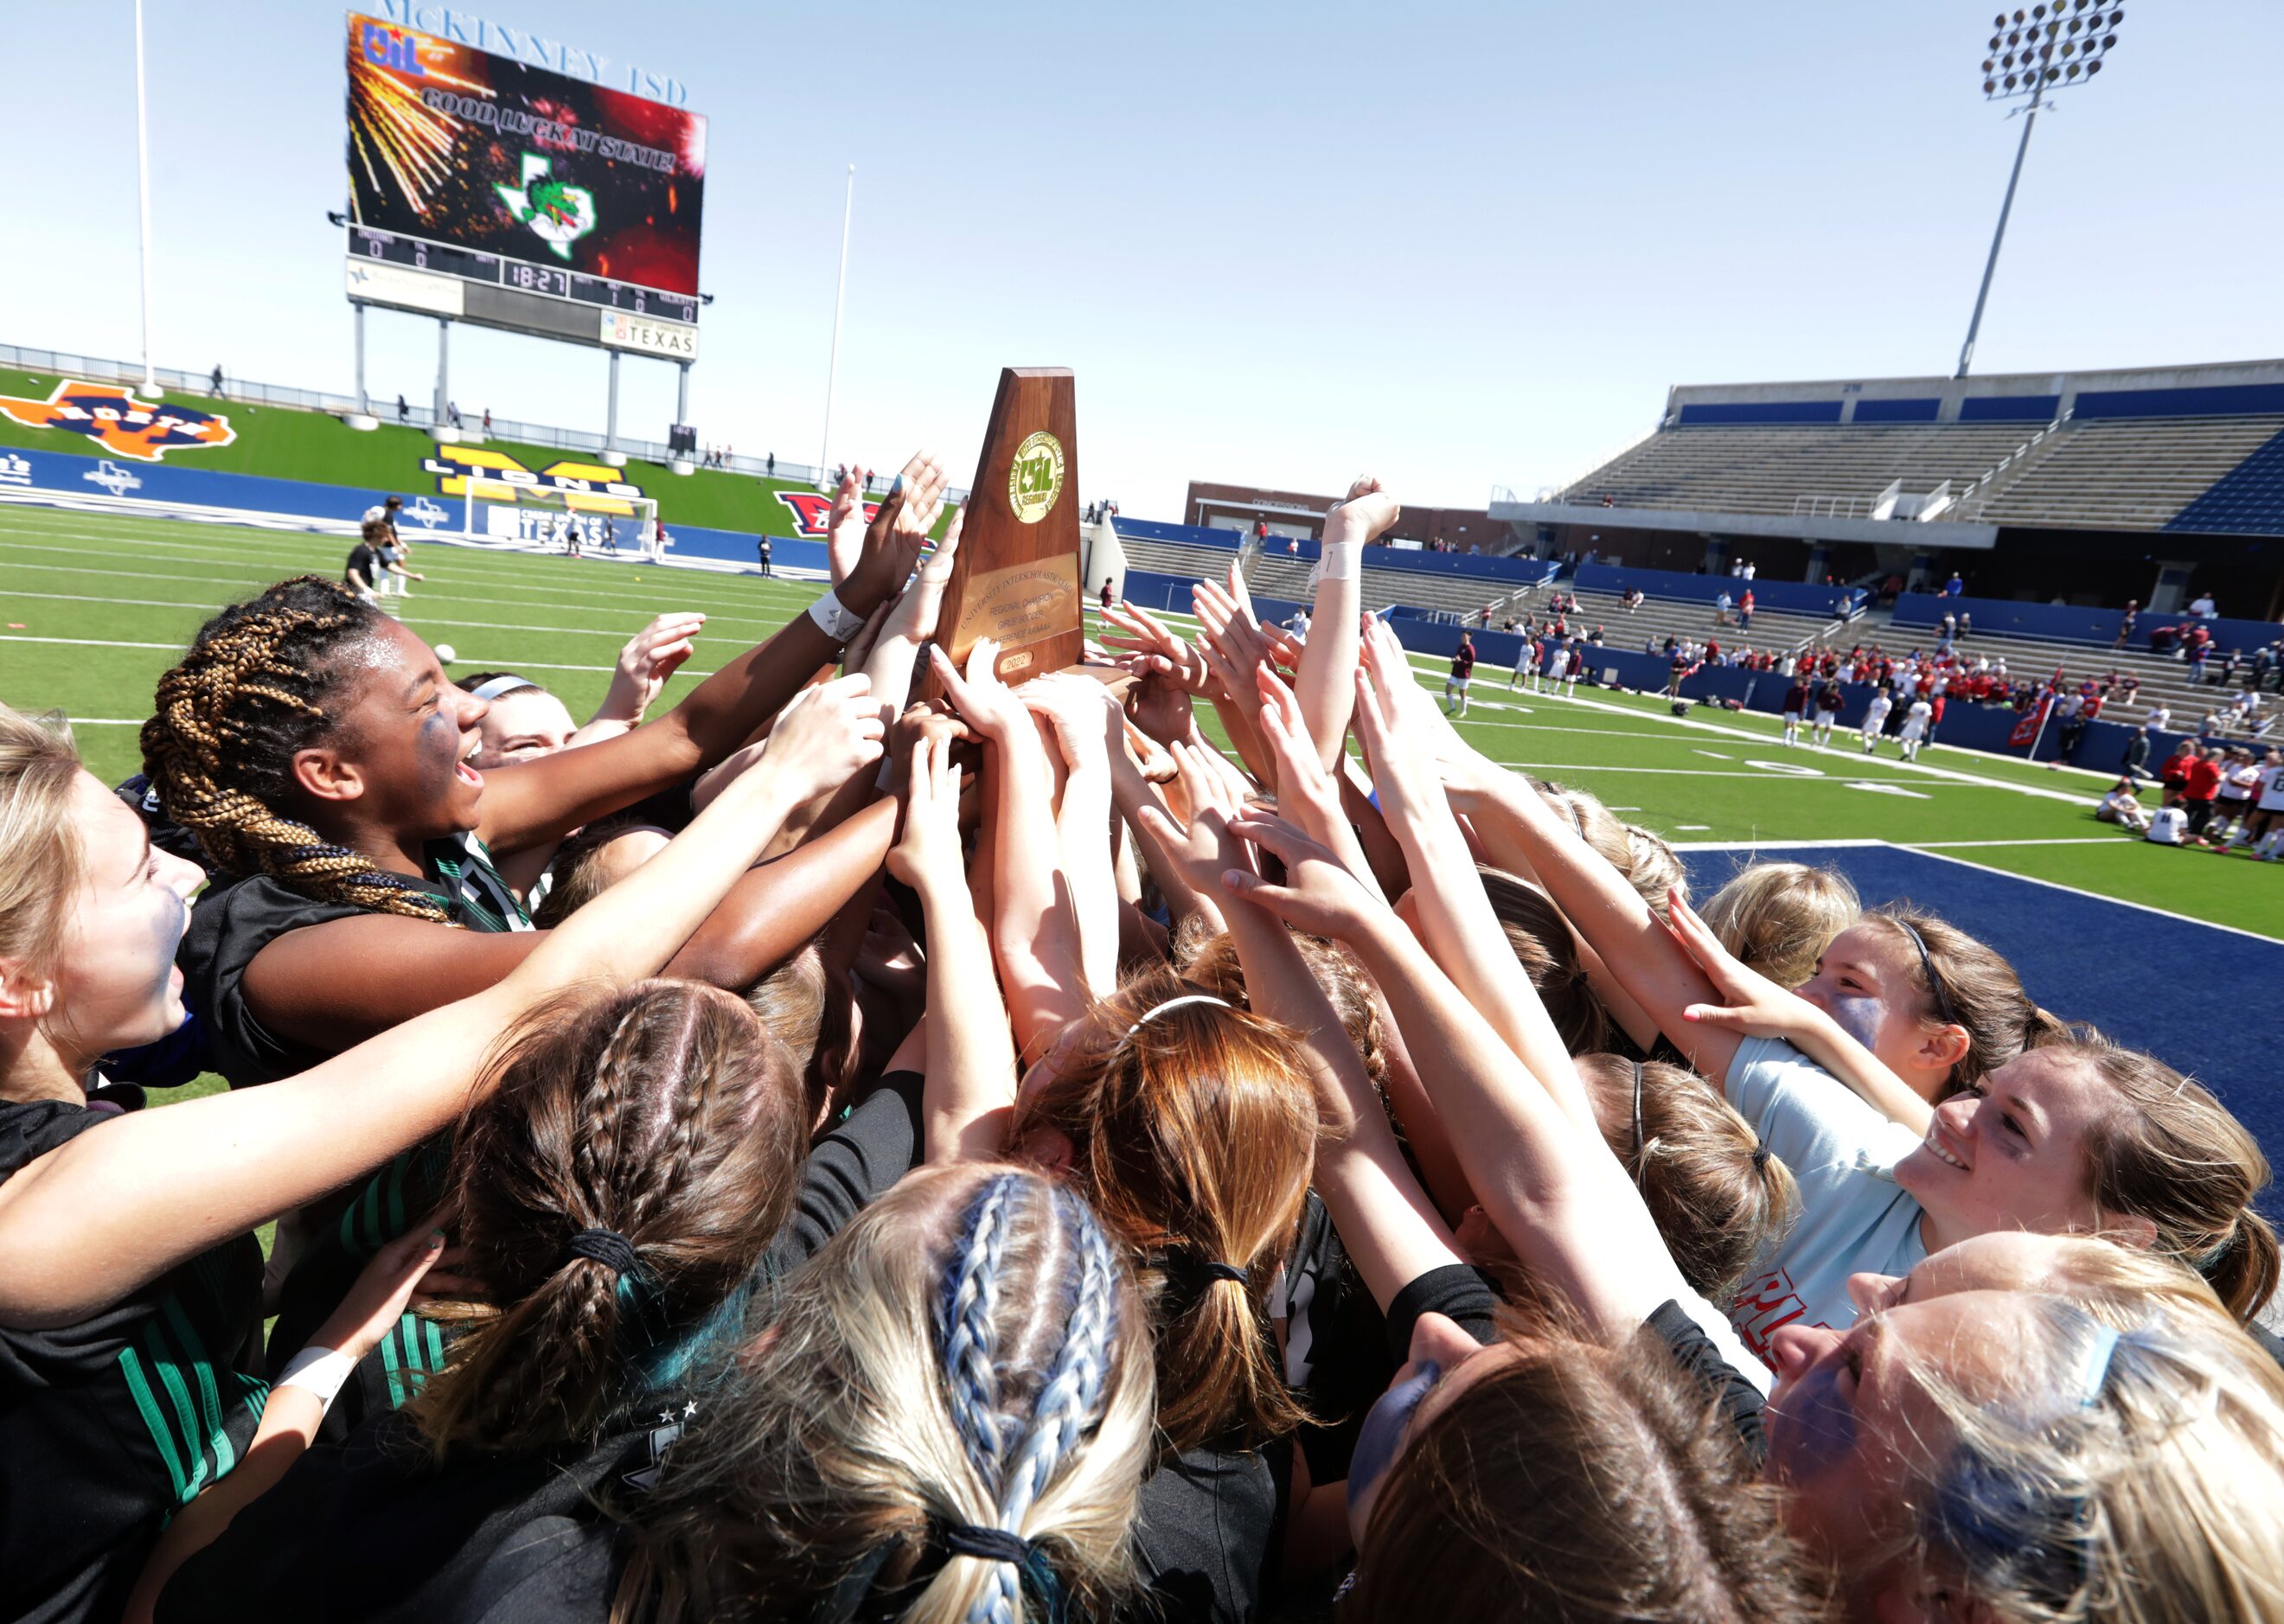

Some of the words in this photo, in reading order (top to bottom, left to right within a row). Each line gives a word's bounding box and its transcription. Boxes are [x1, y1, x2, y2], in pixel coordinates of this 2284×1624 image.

[626, 64, 689, 105] ISD
[421, 87, 497, 126] GOOD
[500, 109, 568, 143] LUCK
[565, 128, 600, 152] AT
[598, 137, 677, 171] STATE!
[512, 265, 565, 292] 18:27
[630, 327, 693, 352] TEXAS
[424, 458, 642, 498] LIONS
[1253, 498, 1310, 511] CONCESSIONS
[521, 518, 603, 547] TEXAS
[961, 584, 1002, 630] UNIVERSITY
[1002, 570, 1059, 589] INTERSCHOLASTIC
[989, 601, 1020, 617] REGIONAL
[1021, 592, 1054, 609] CHAMPION
[1019, 610, 1044, 624] SOCCER
[988, 629, 1027, 645] ONFERENCE
[1006, 655, 1027, 670] 2022
